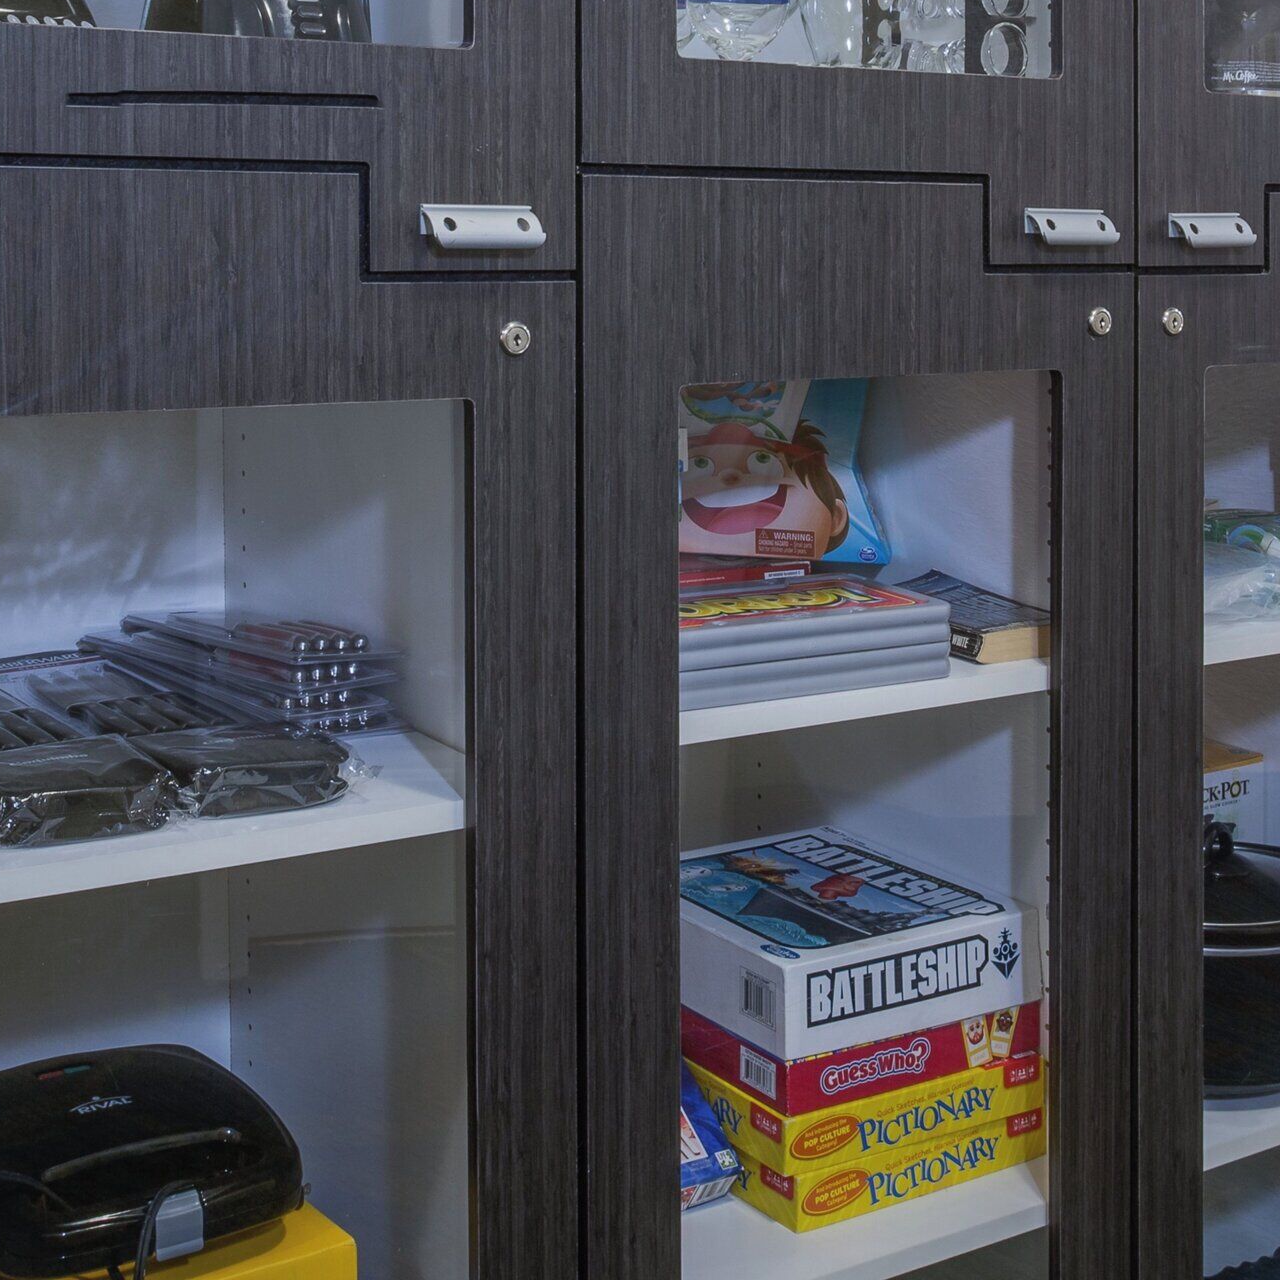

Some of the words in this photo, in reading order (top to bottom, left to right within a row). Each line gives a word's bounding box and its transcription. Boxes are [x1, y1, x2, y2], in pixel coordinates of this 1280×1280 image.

[1235, 69, 1260, 84] Coffee
[773, 531, 814, 542] WARNING:
[951, 633, 970, 649] WHITE
[774, 838, 1000, 916] BATTLESHIP
[810, 940, 985, 1023] BATTLESHIP
[822, 1047, 879, 1091] Guess
[878, 1039, 929, 1074] Who?
[77, 1097, 133, 1115] RIVAL
[857, 1085, 996, 1152] PICTIONARY
[803, 1137, 819, 1149] POP
[819, 1124, 851, 1143] CULTURE
[866, 1134, 999, 1206] PICTIONARY
[814, 1193, 830, 1205] POP
[830, 1179, 860, 1198] CULTURE
